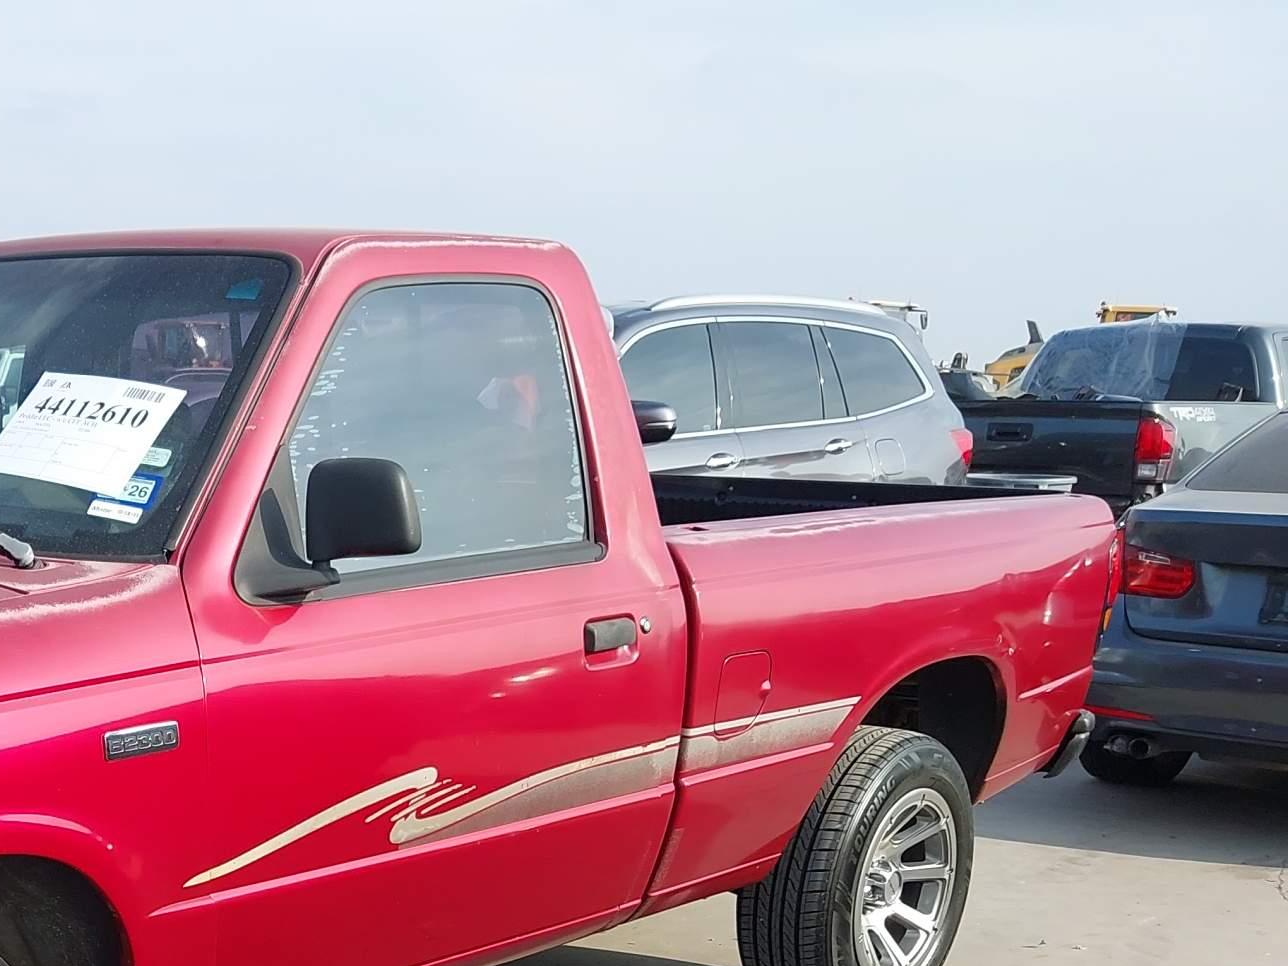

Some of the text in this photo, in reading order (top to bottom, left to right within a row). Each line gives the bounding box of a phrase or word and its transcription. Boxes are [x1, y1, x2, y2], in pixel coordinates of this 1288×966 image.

[34, 395, 149, 429] 44112610
[1169, 406, 1195, 421] TRD
[127, 484, 150, 498] 26
[109, 730, 177, 755] B2300
